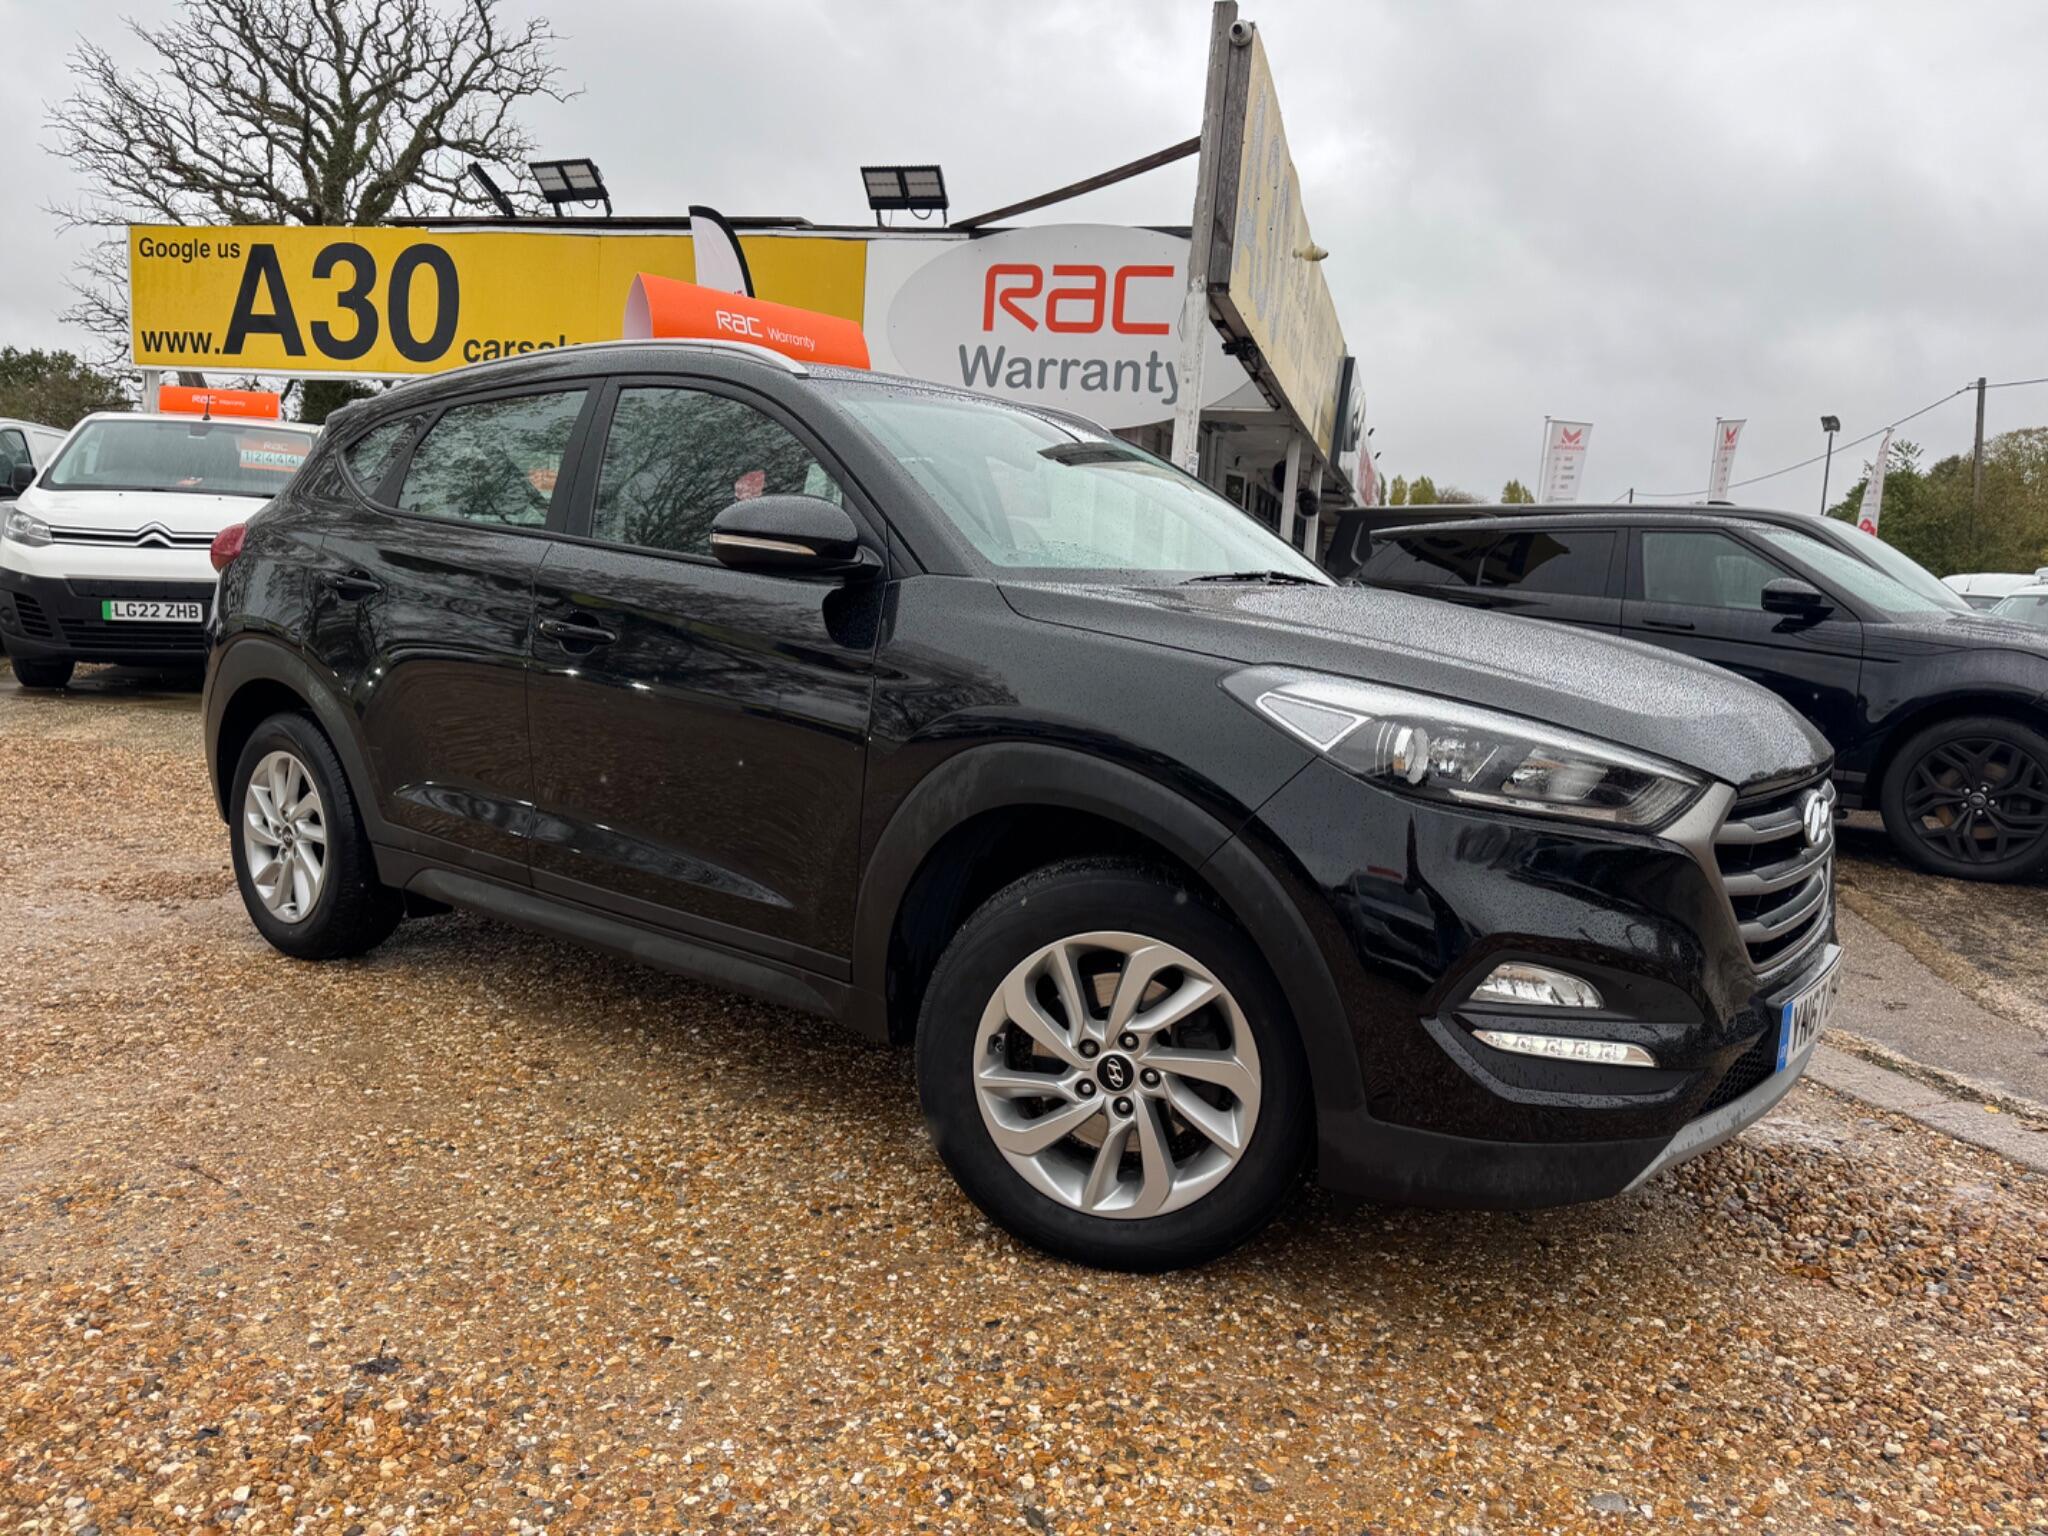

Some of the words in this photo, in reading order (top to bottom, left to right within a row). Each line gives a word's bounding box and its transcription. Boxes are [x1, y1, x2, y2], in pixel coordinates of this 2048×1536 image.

[139, 237, 211, 263] Google
[217, 242, 241, 258] us
[766, 327, 816, 353] Warranty
[958, 344, 1178, 405] Warranty
[114, 602, 160, 618] LG22
[165, 604, 199, 619] ZHB
